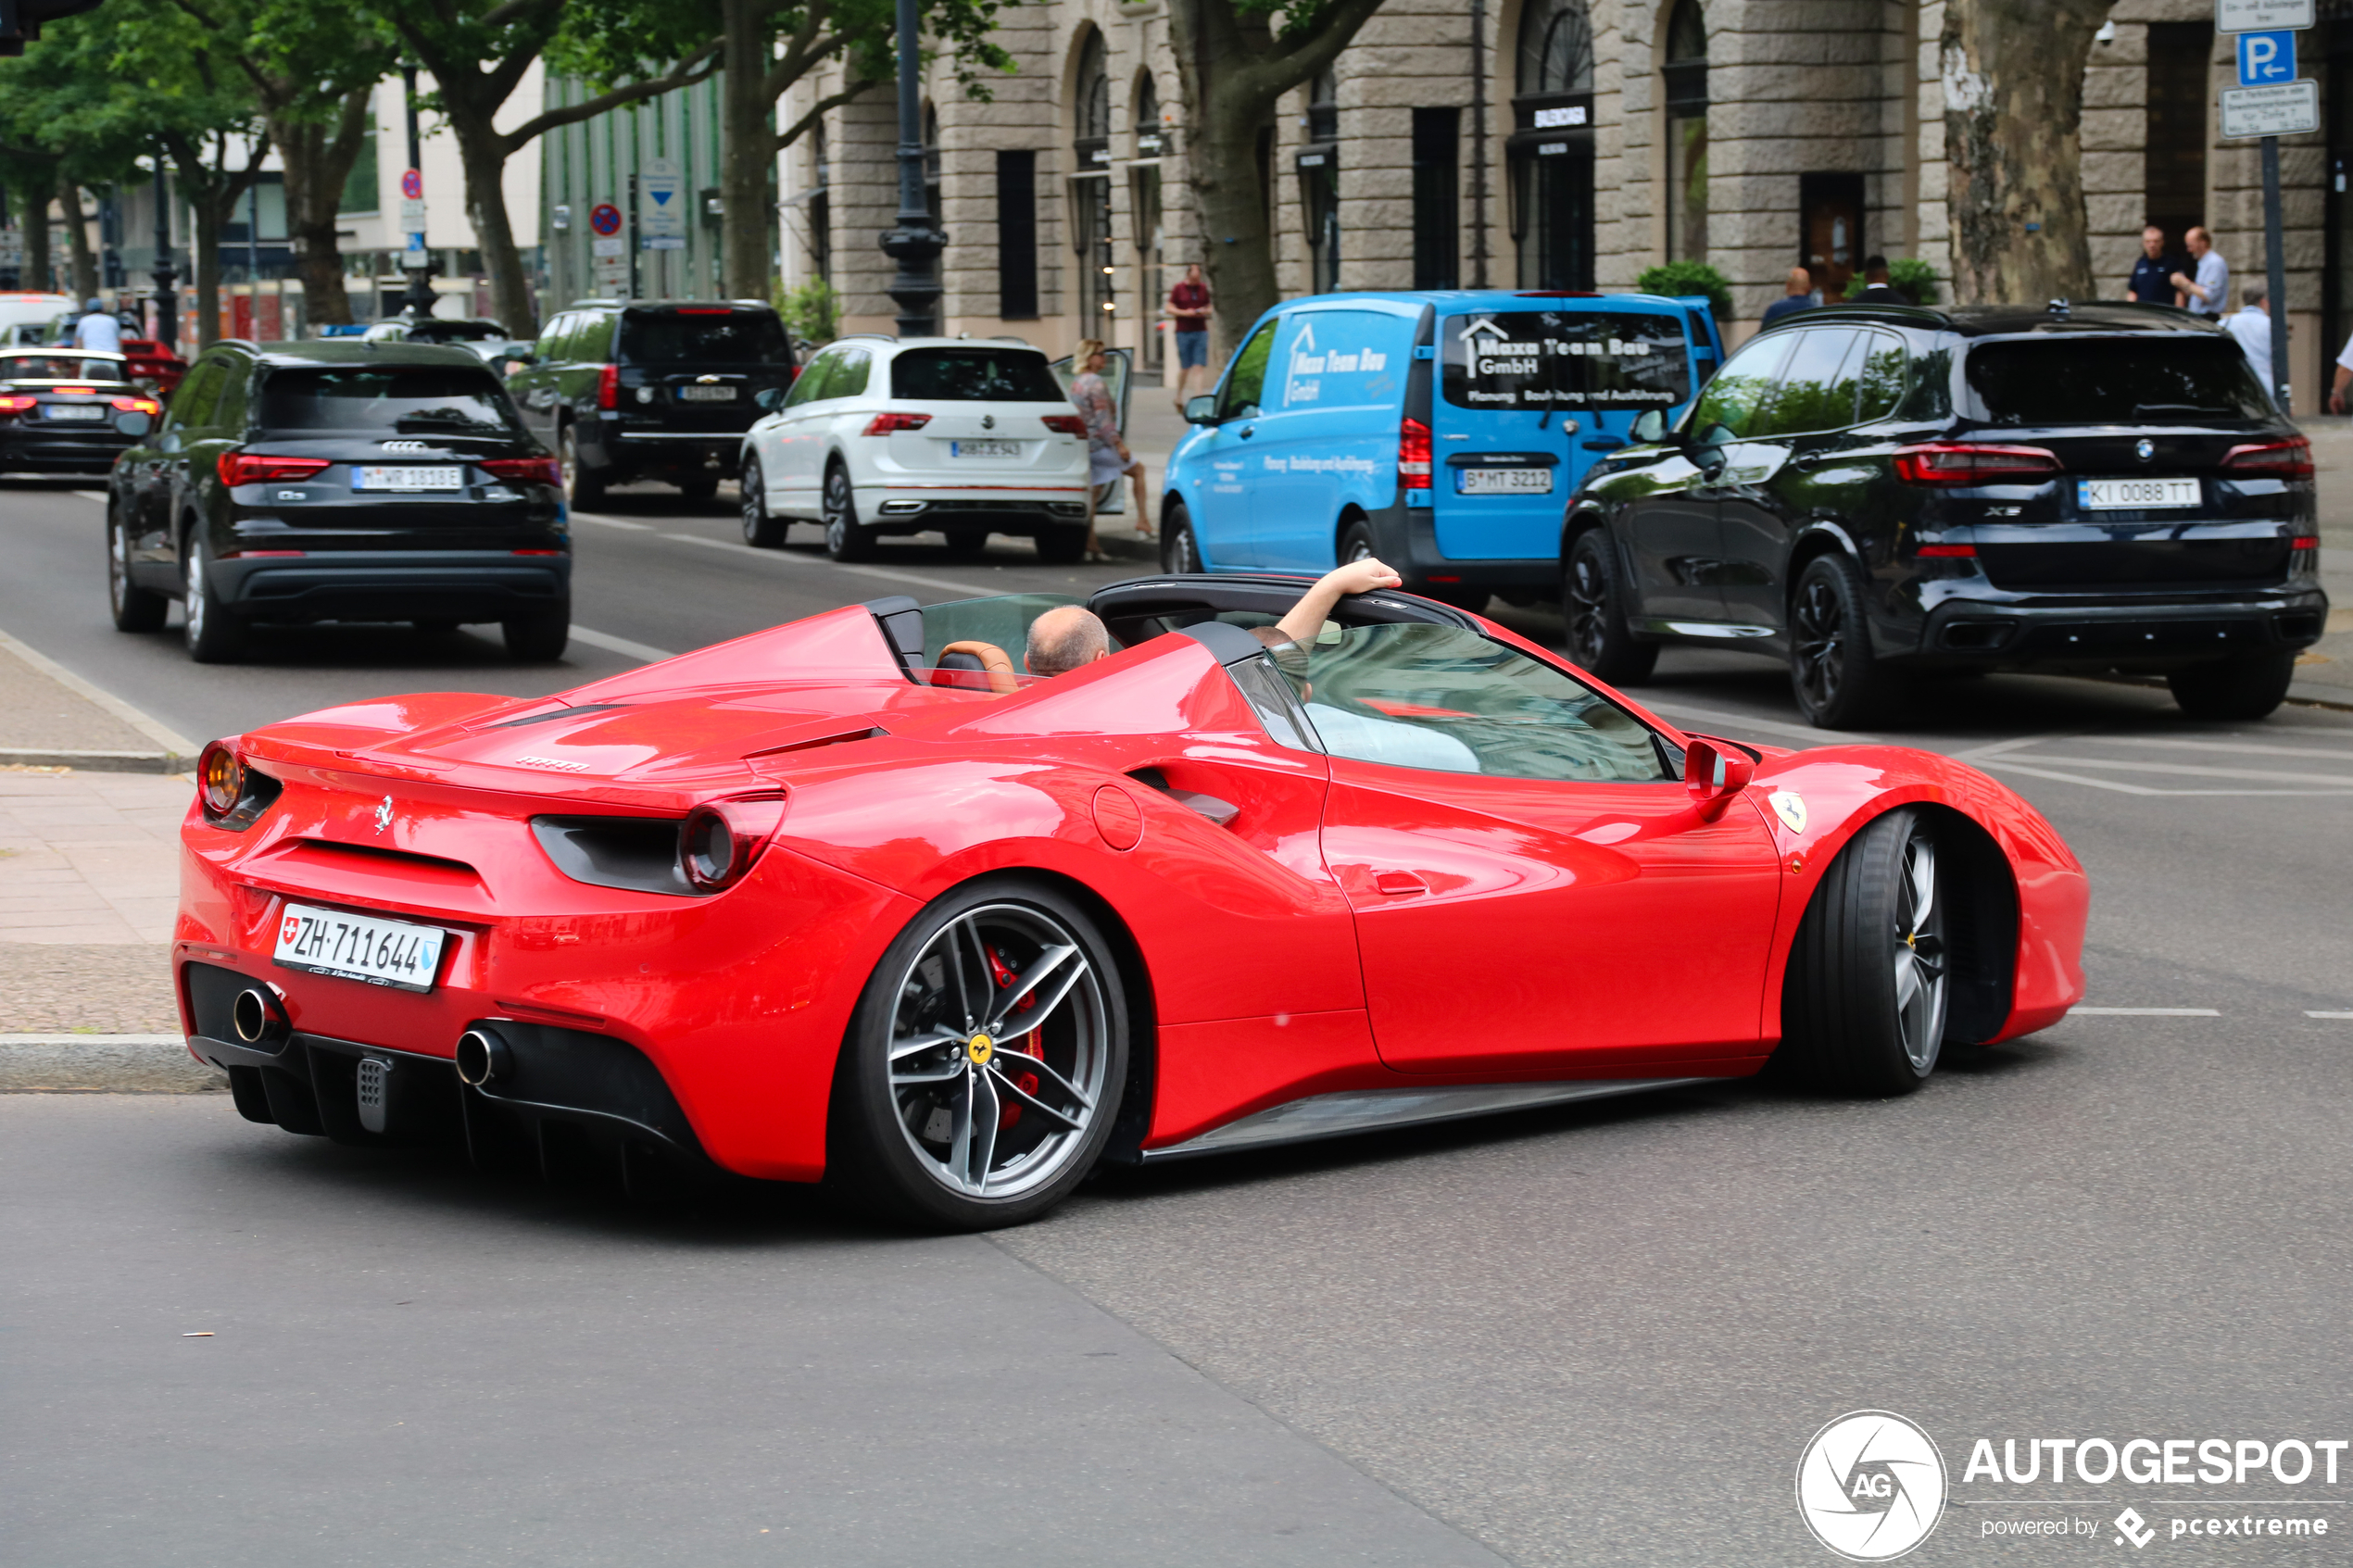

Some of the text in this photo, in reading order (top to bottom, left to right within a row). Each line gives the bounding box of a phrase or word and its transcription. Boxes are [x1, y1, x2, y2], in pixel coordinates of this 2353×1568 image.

[2246, 36, 2278, 80] P
[1478, 338, 1650, 356] Maxa Team Bau
[1479, 358, 1538, 374] GmbH
[1466, 471, 1477, 487] B
[1511, 471, 1548, 487] 3212
[2090, 483, 2194, 503] KI 0088 TT
